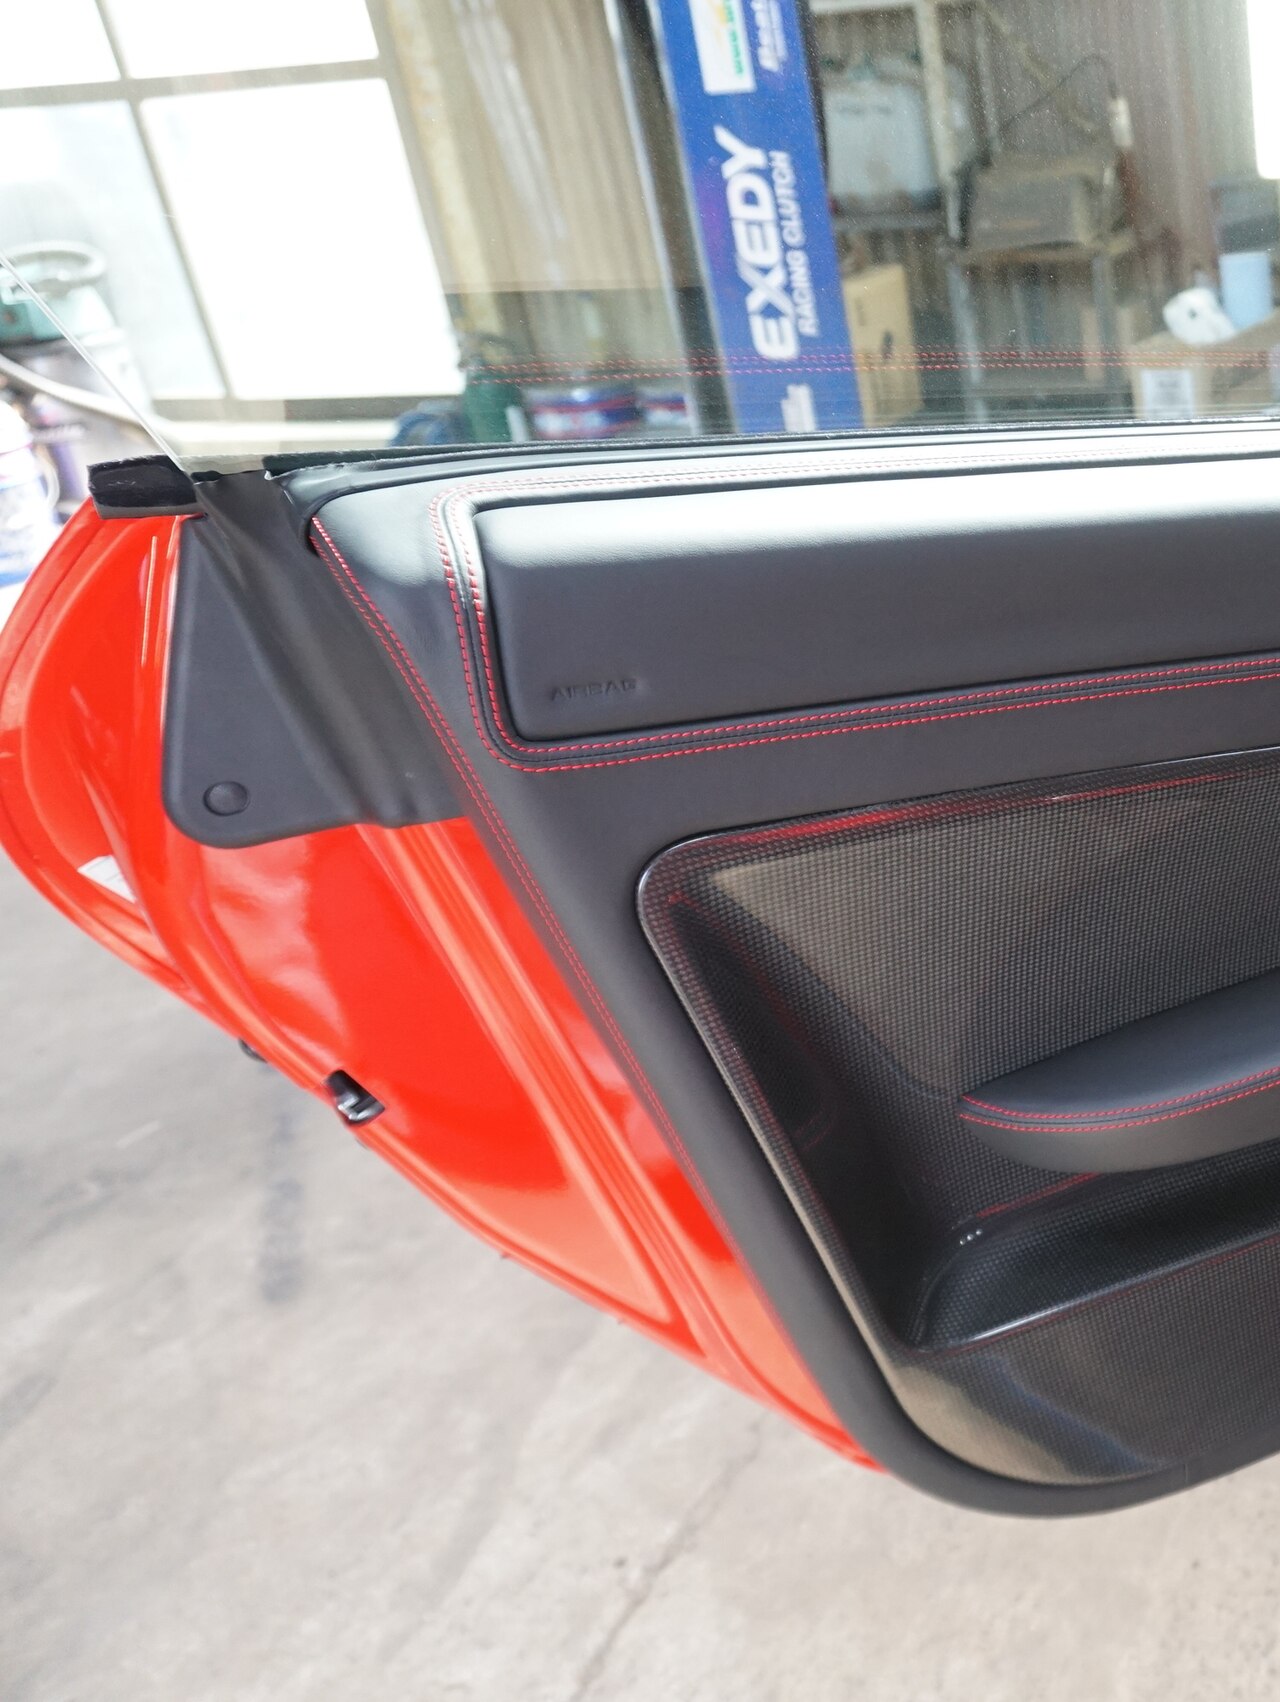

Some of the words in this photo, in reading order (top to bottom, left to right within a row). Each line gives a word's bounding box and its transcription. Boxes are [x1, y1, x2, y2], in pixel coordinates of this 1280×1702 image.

[713, 125, 797, 360] EXEDY
[768, 150, 806, 248] CLUTCH
[786, 249, 820, 337] RACING
[550, 677, 638, 702] AIRBAG
